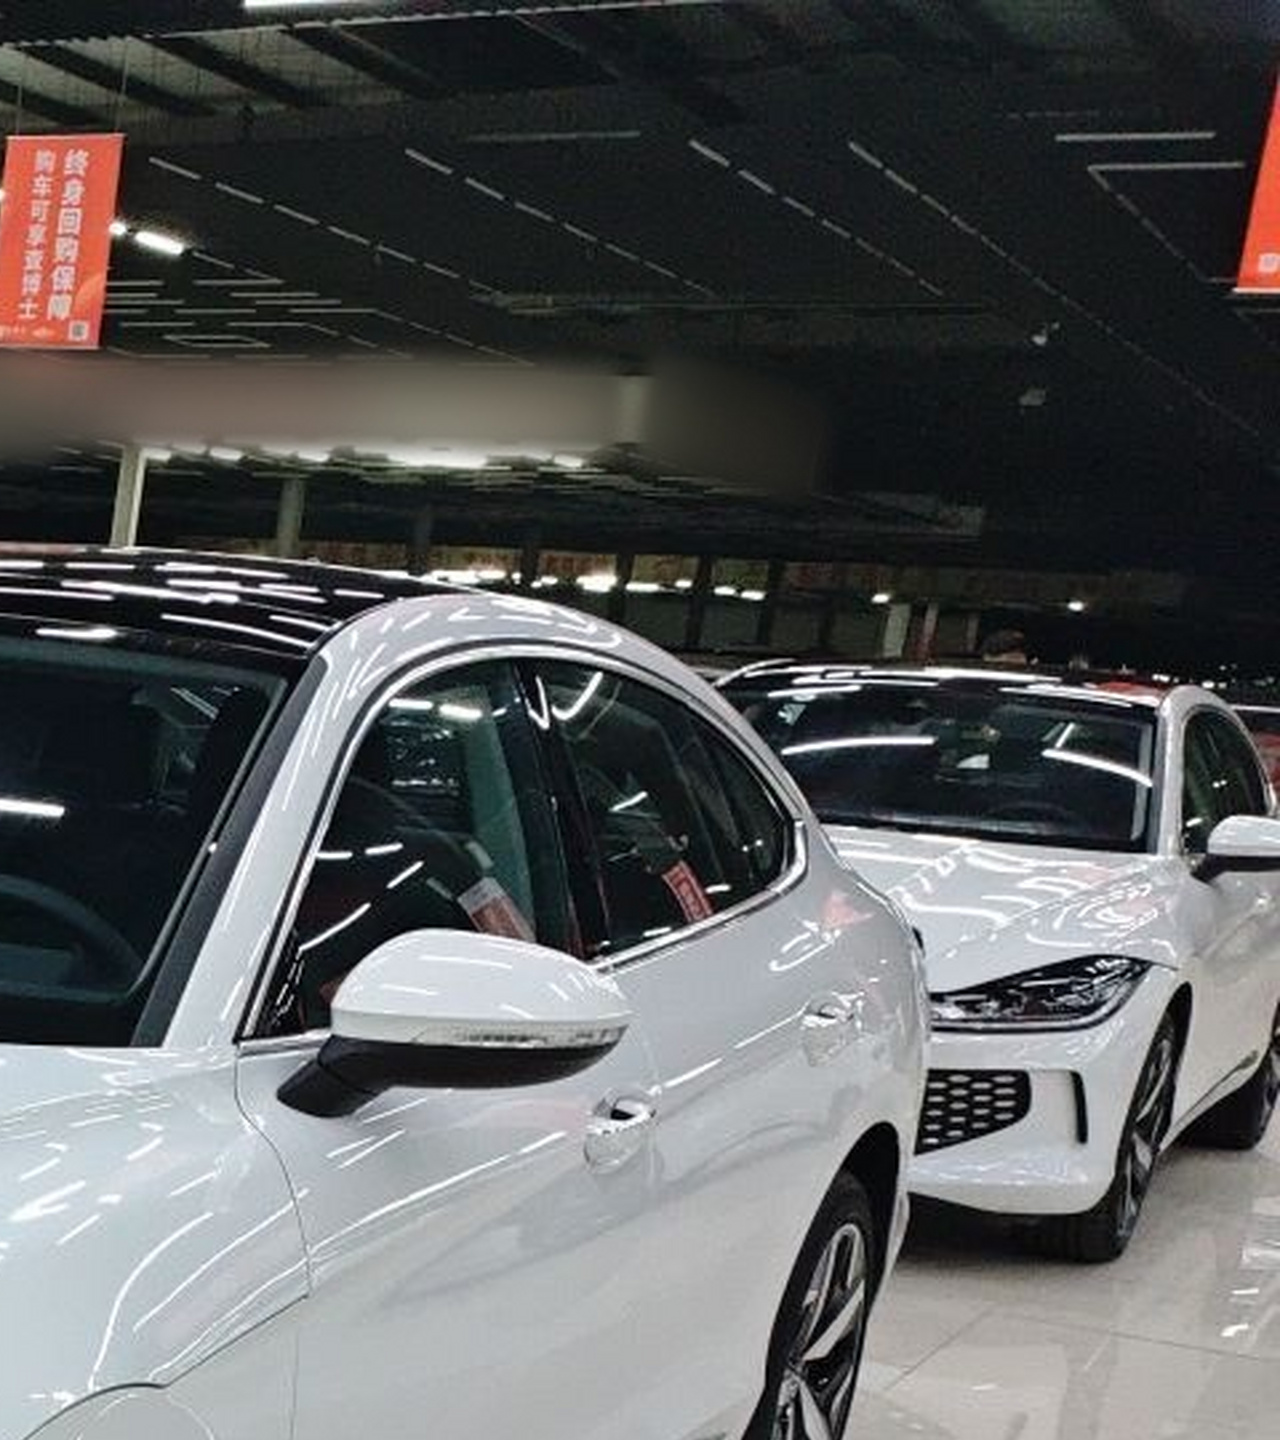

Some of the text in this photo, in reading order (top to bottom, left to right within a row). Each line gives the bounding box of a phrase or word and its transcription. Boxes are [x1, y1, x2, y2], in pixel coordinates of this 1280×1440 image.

[46, 149, 90, 321] 终身回购保障
